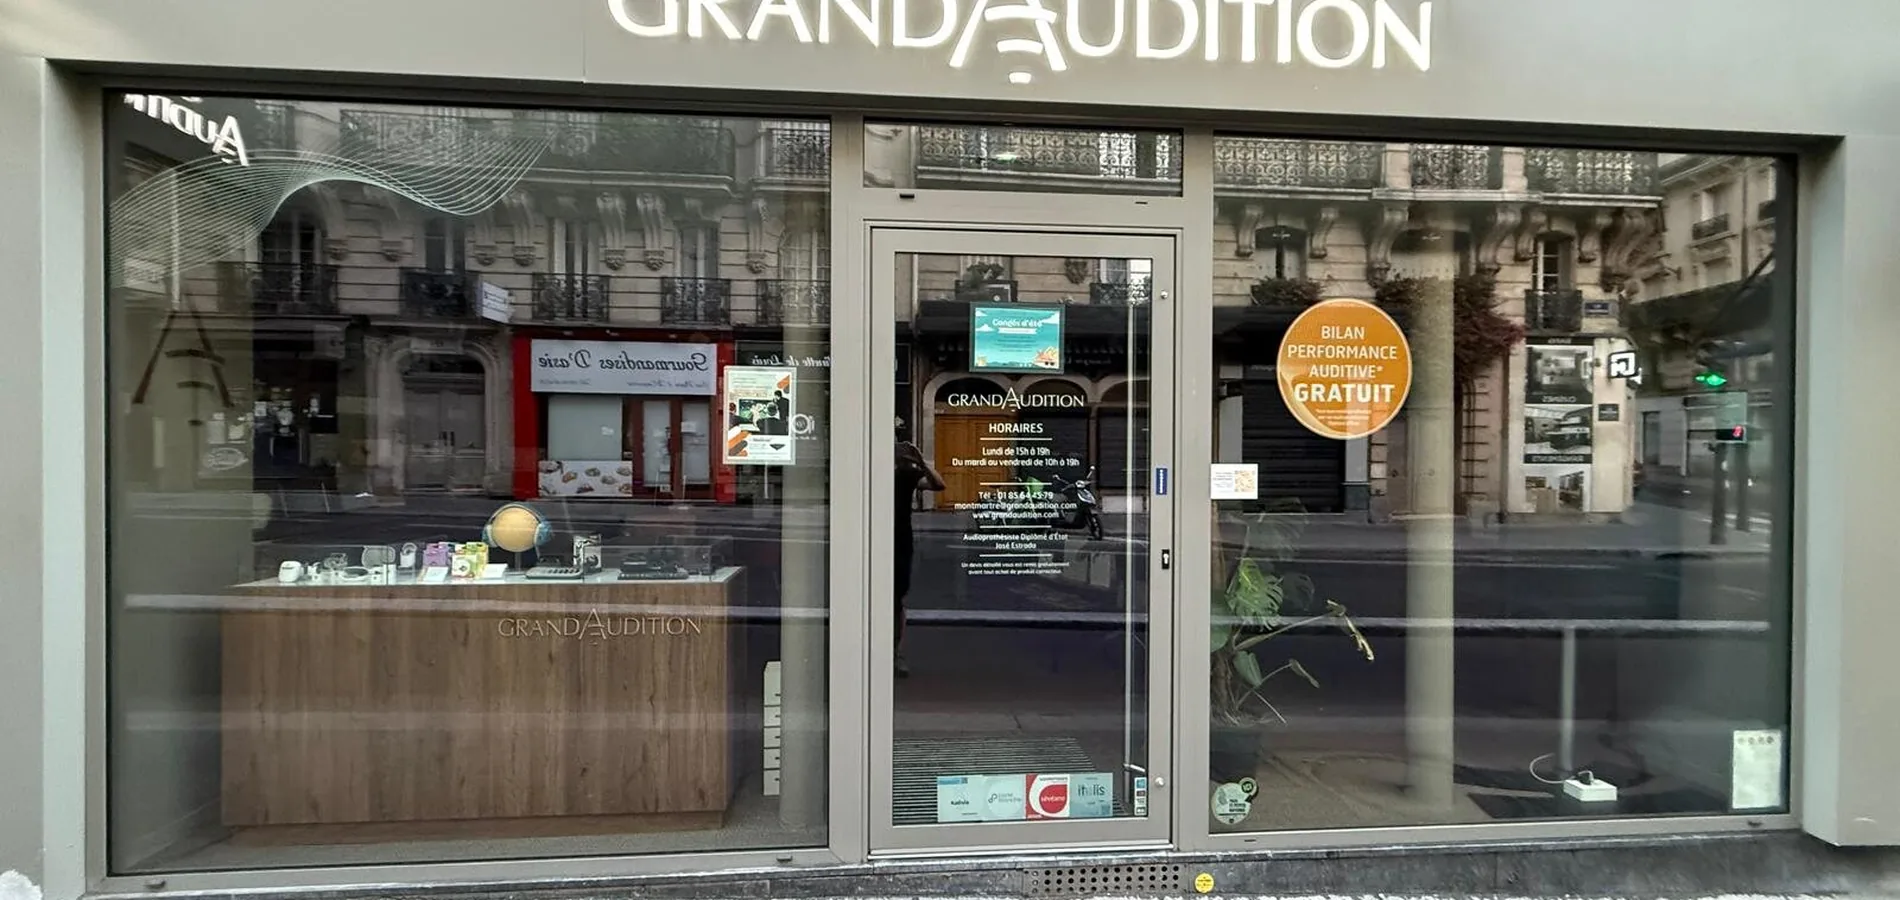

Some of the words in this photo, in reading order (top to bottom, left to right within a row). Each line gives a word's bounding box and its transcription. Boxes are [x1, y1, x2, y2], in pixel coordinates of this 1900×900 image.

[1321, 325, 1365, 340] BILAN
[1287, 344, 1397, 360] PERFORMANCE
[948, 387, 1084, 412] GRANDAUDITION
[1293, 382, 1395, 403] GRATUIT
[988, 422, 1044, 434] HORAIRES
[982, 446, 1003, 456] Lundi
[1004, 446, 1015, 456] de
[1016, 446, 1029, 456] 15h
[1030, 446, 1036, 456] à
[1037, 446, 1051, 456] 19h
[952, 457, 963, 467] Du
[964, 457, 987, 467] mardi
[988, 457, 998, 467] au
[999, 457, 1032, 467] vendredi
[1033, 457, 1043, 467] de
[1045, 457, 1059, 467] 10h
[1060, 457, 1065, 467] à
[1066, 457, 1080, 467] 19h
[995, 542, 1010, 550] José
[1011, 542, 1037, 550] Estrada
[498, 608, 701, 646] GRANDAUDITION
